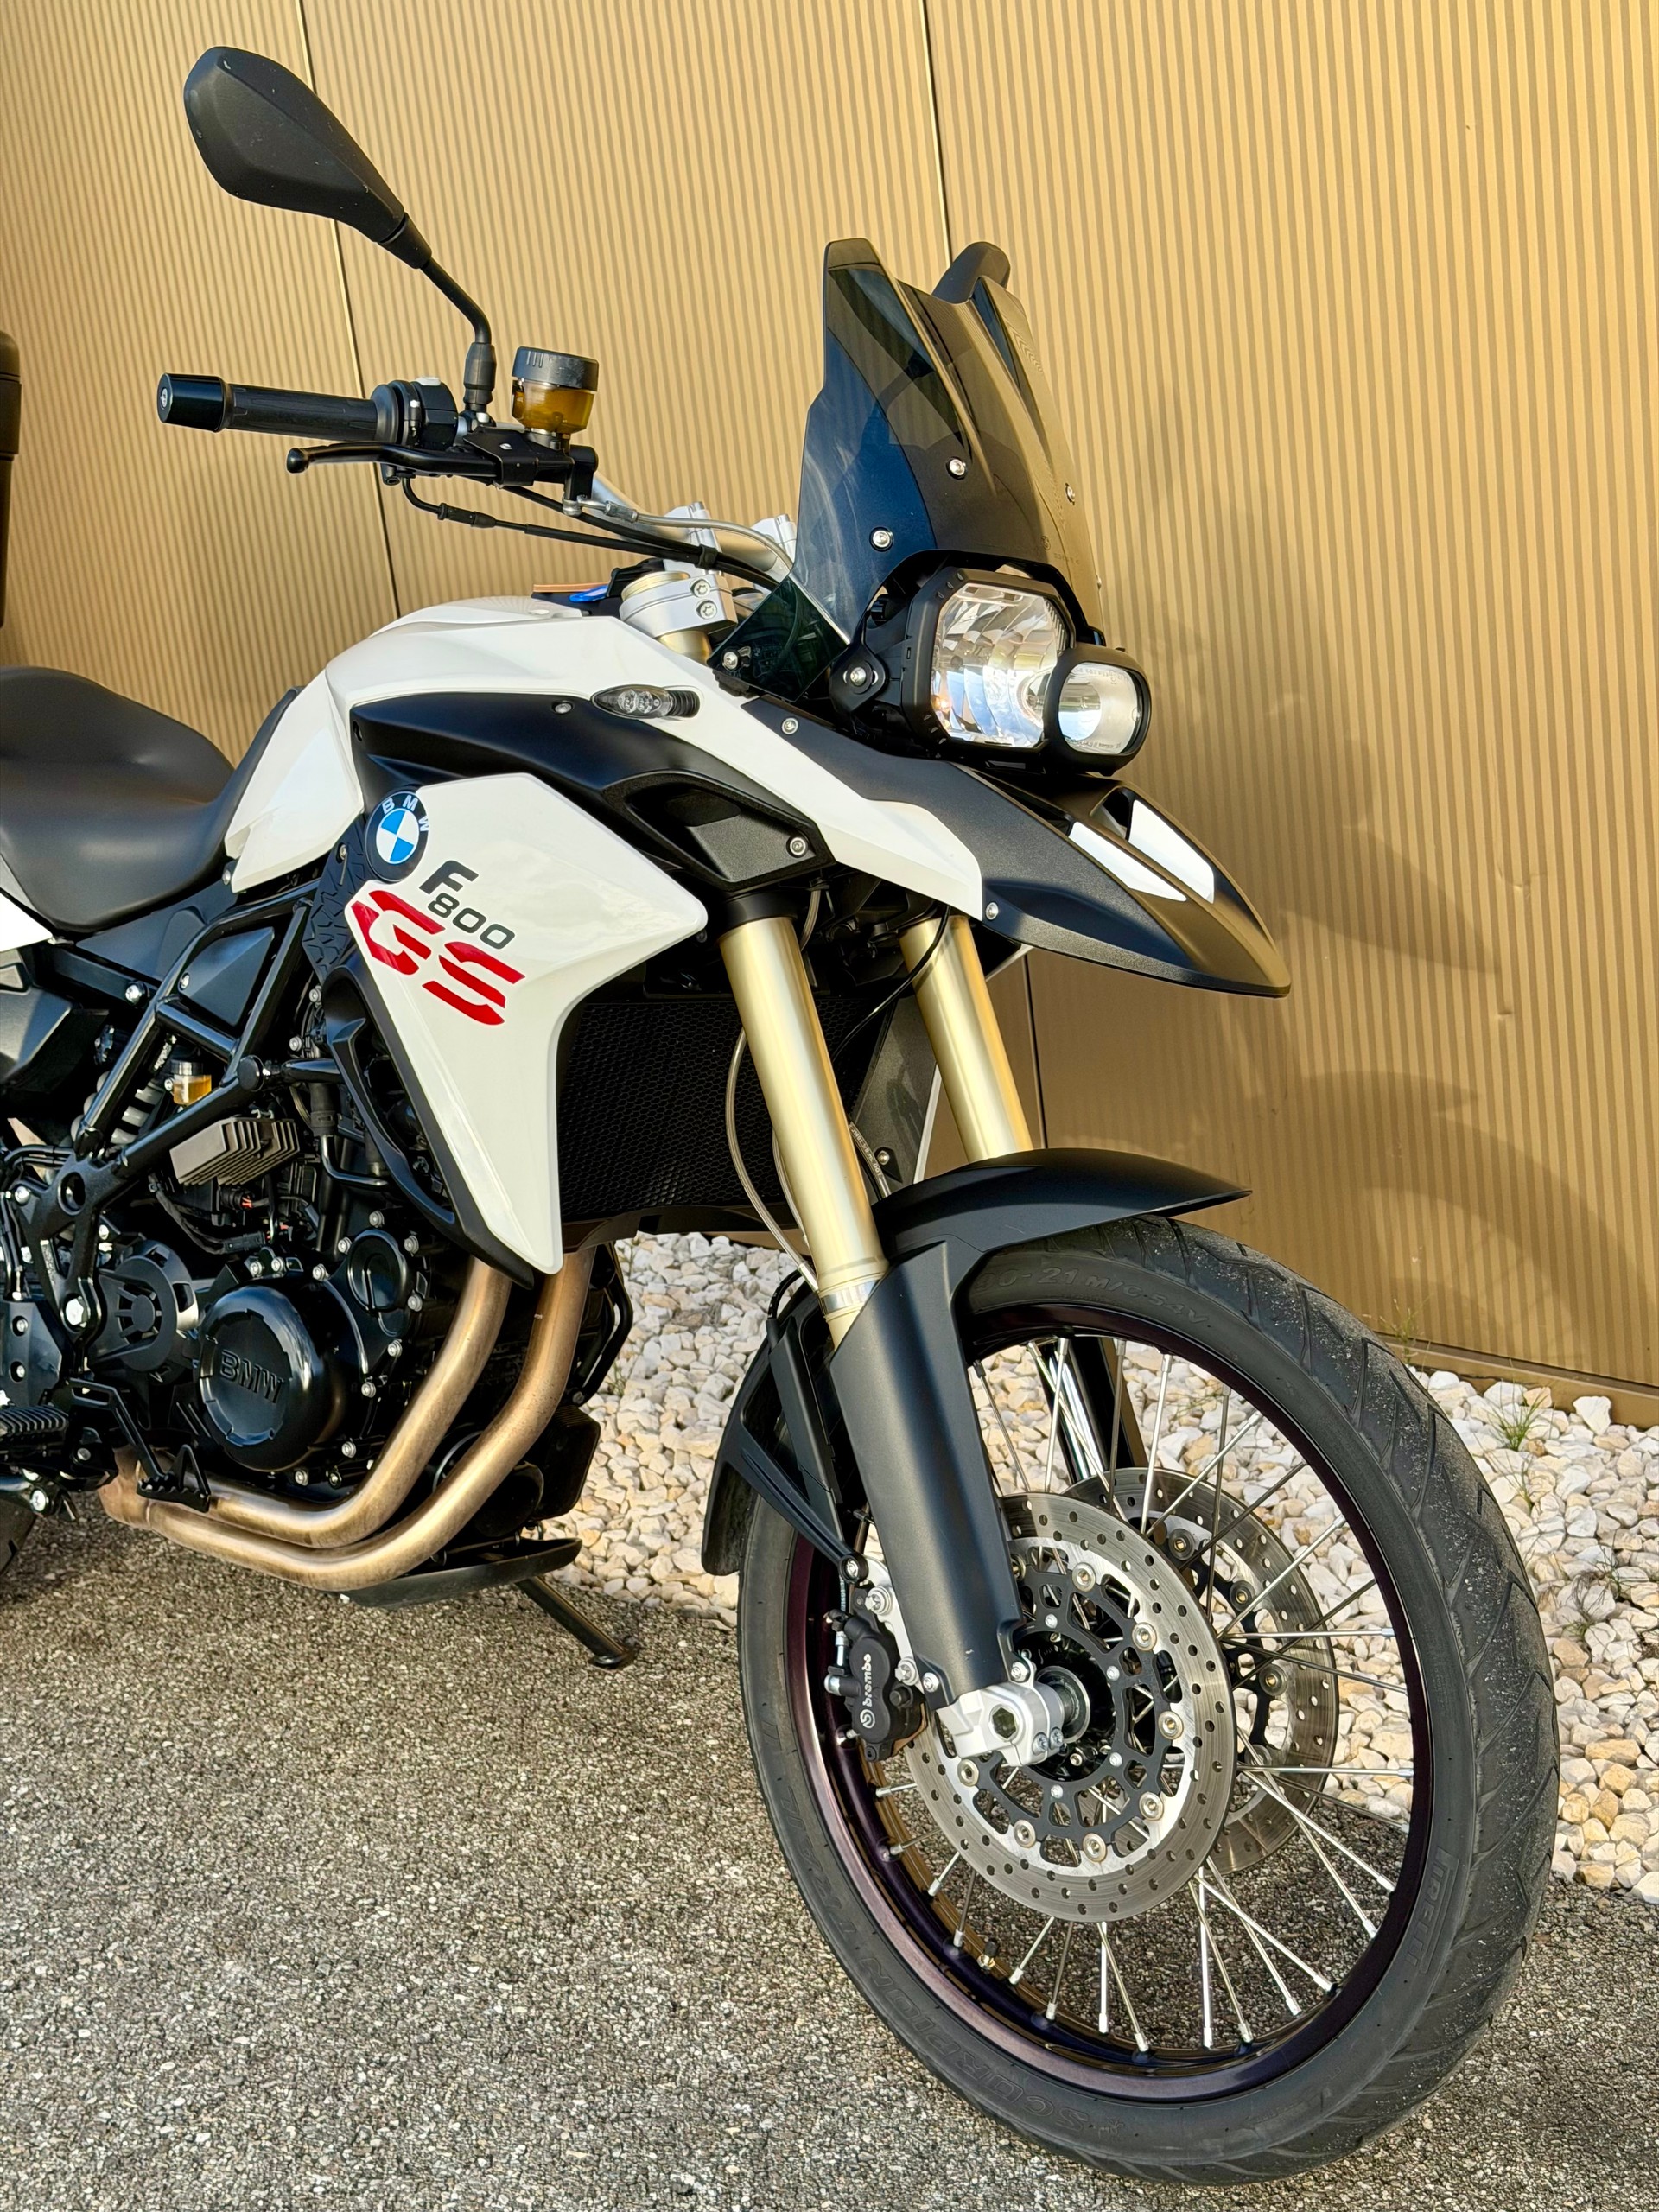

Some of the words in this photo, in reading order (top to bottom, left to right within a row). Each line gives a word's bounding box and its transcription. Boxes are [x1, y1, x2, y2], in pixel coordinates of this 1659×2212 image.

[381, 794, 430, 832] BMW
[418, 860, 480, 894] F
[427, 892, 516, 950] 800
[350, 890, 526, 1026] GS
[219, 1349, 284, 1404] BMW
[861, 1653, 874, 1707] brembo
